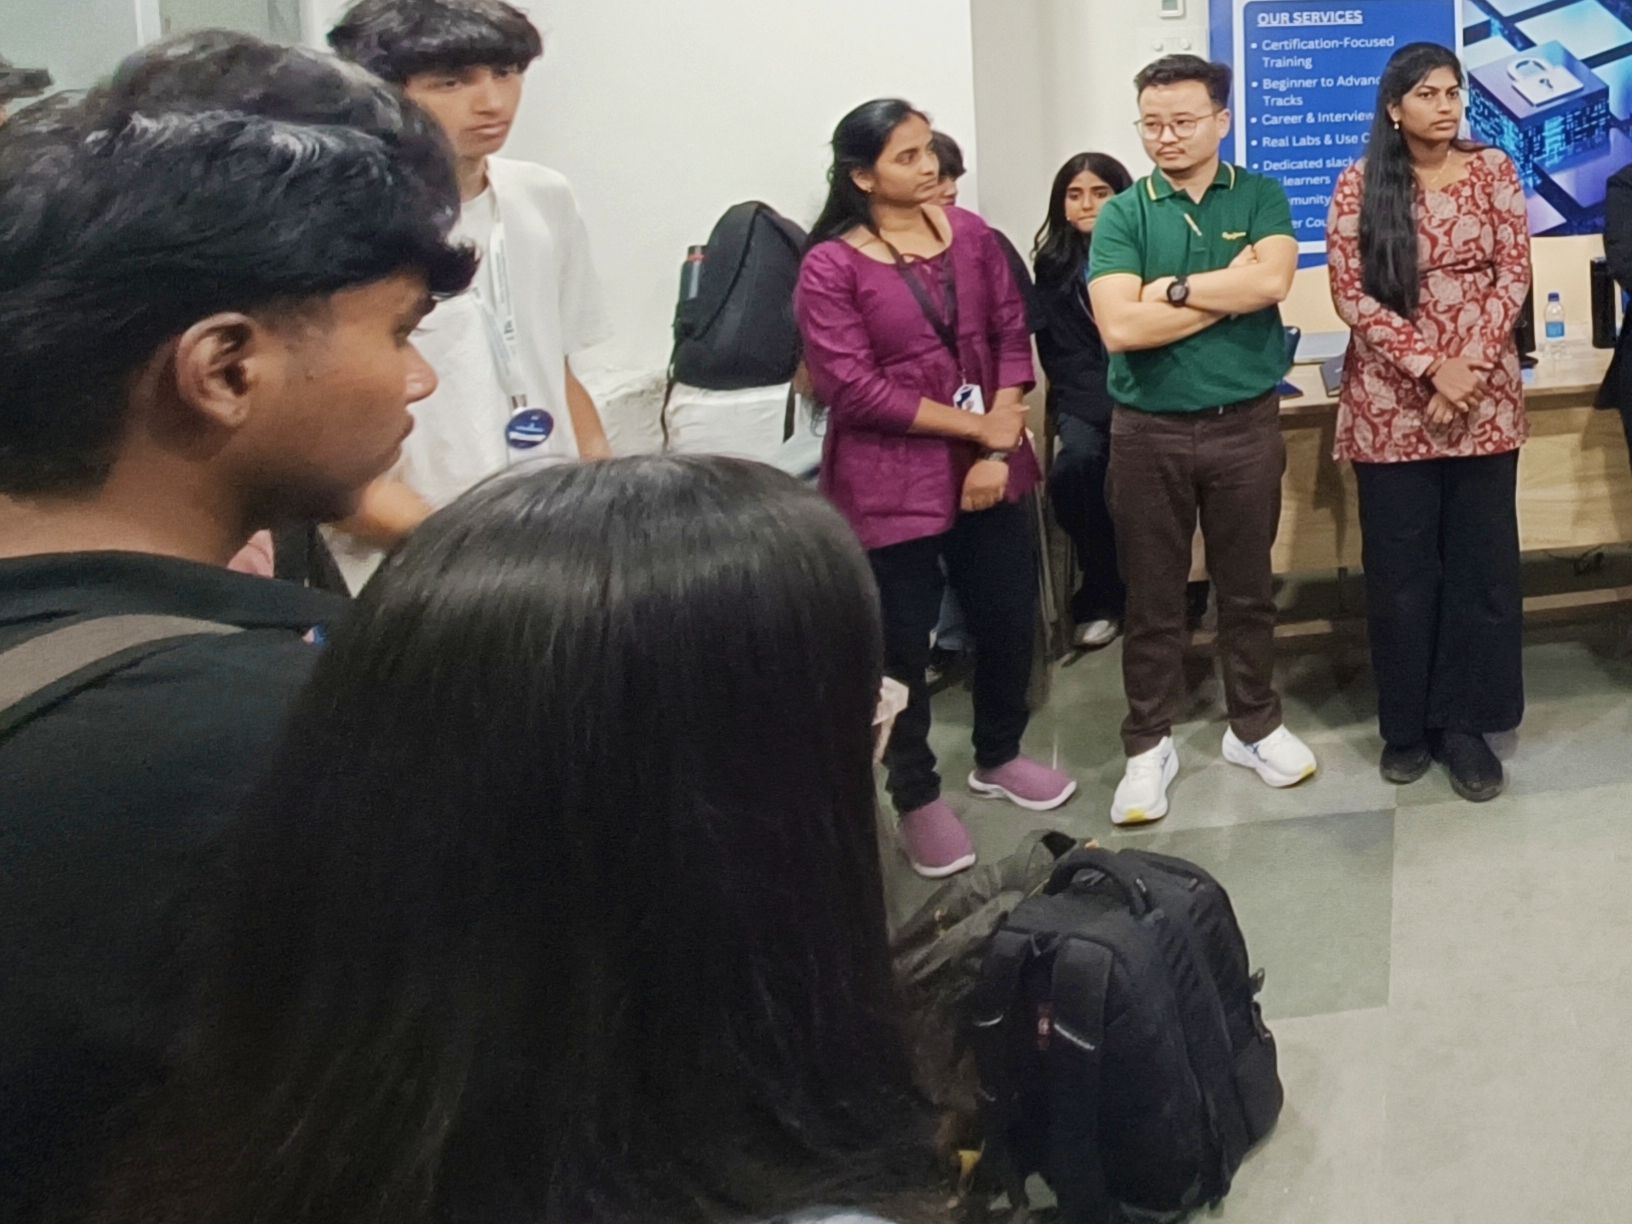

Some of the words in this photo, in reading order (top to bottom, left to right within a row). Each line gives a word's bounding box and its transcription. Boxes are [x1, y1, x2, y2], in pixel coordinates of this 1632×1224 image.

[1257, 12, 1290, 26] OUR
[1293, 10, 1363, 25] SERVICES
[1262, 35, 1395, 51] Certification-Focused
[1262, 56, 1313, 70] Training
[1262, 77, 1318, 92] Beginner
[1321, 77, 1334, 87] to
[1262, 94, 1303, 107] Tracks
[1261, 114, 1303, 125] Career
[1306, 112, 1315, 123] &
[1262, 137, 1289, 147] Real
[1292, 135, 1321, 147] Labs
[1323, 134, 1333, 145] &
[1335, 133, 1358, 145] Use
[1263, 159, 1323, 171] Dedicated
[1283, 175, 1331, 186] learners
[1289, 195, 1332, 207] munity
